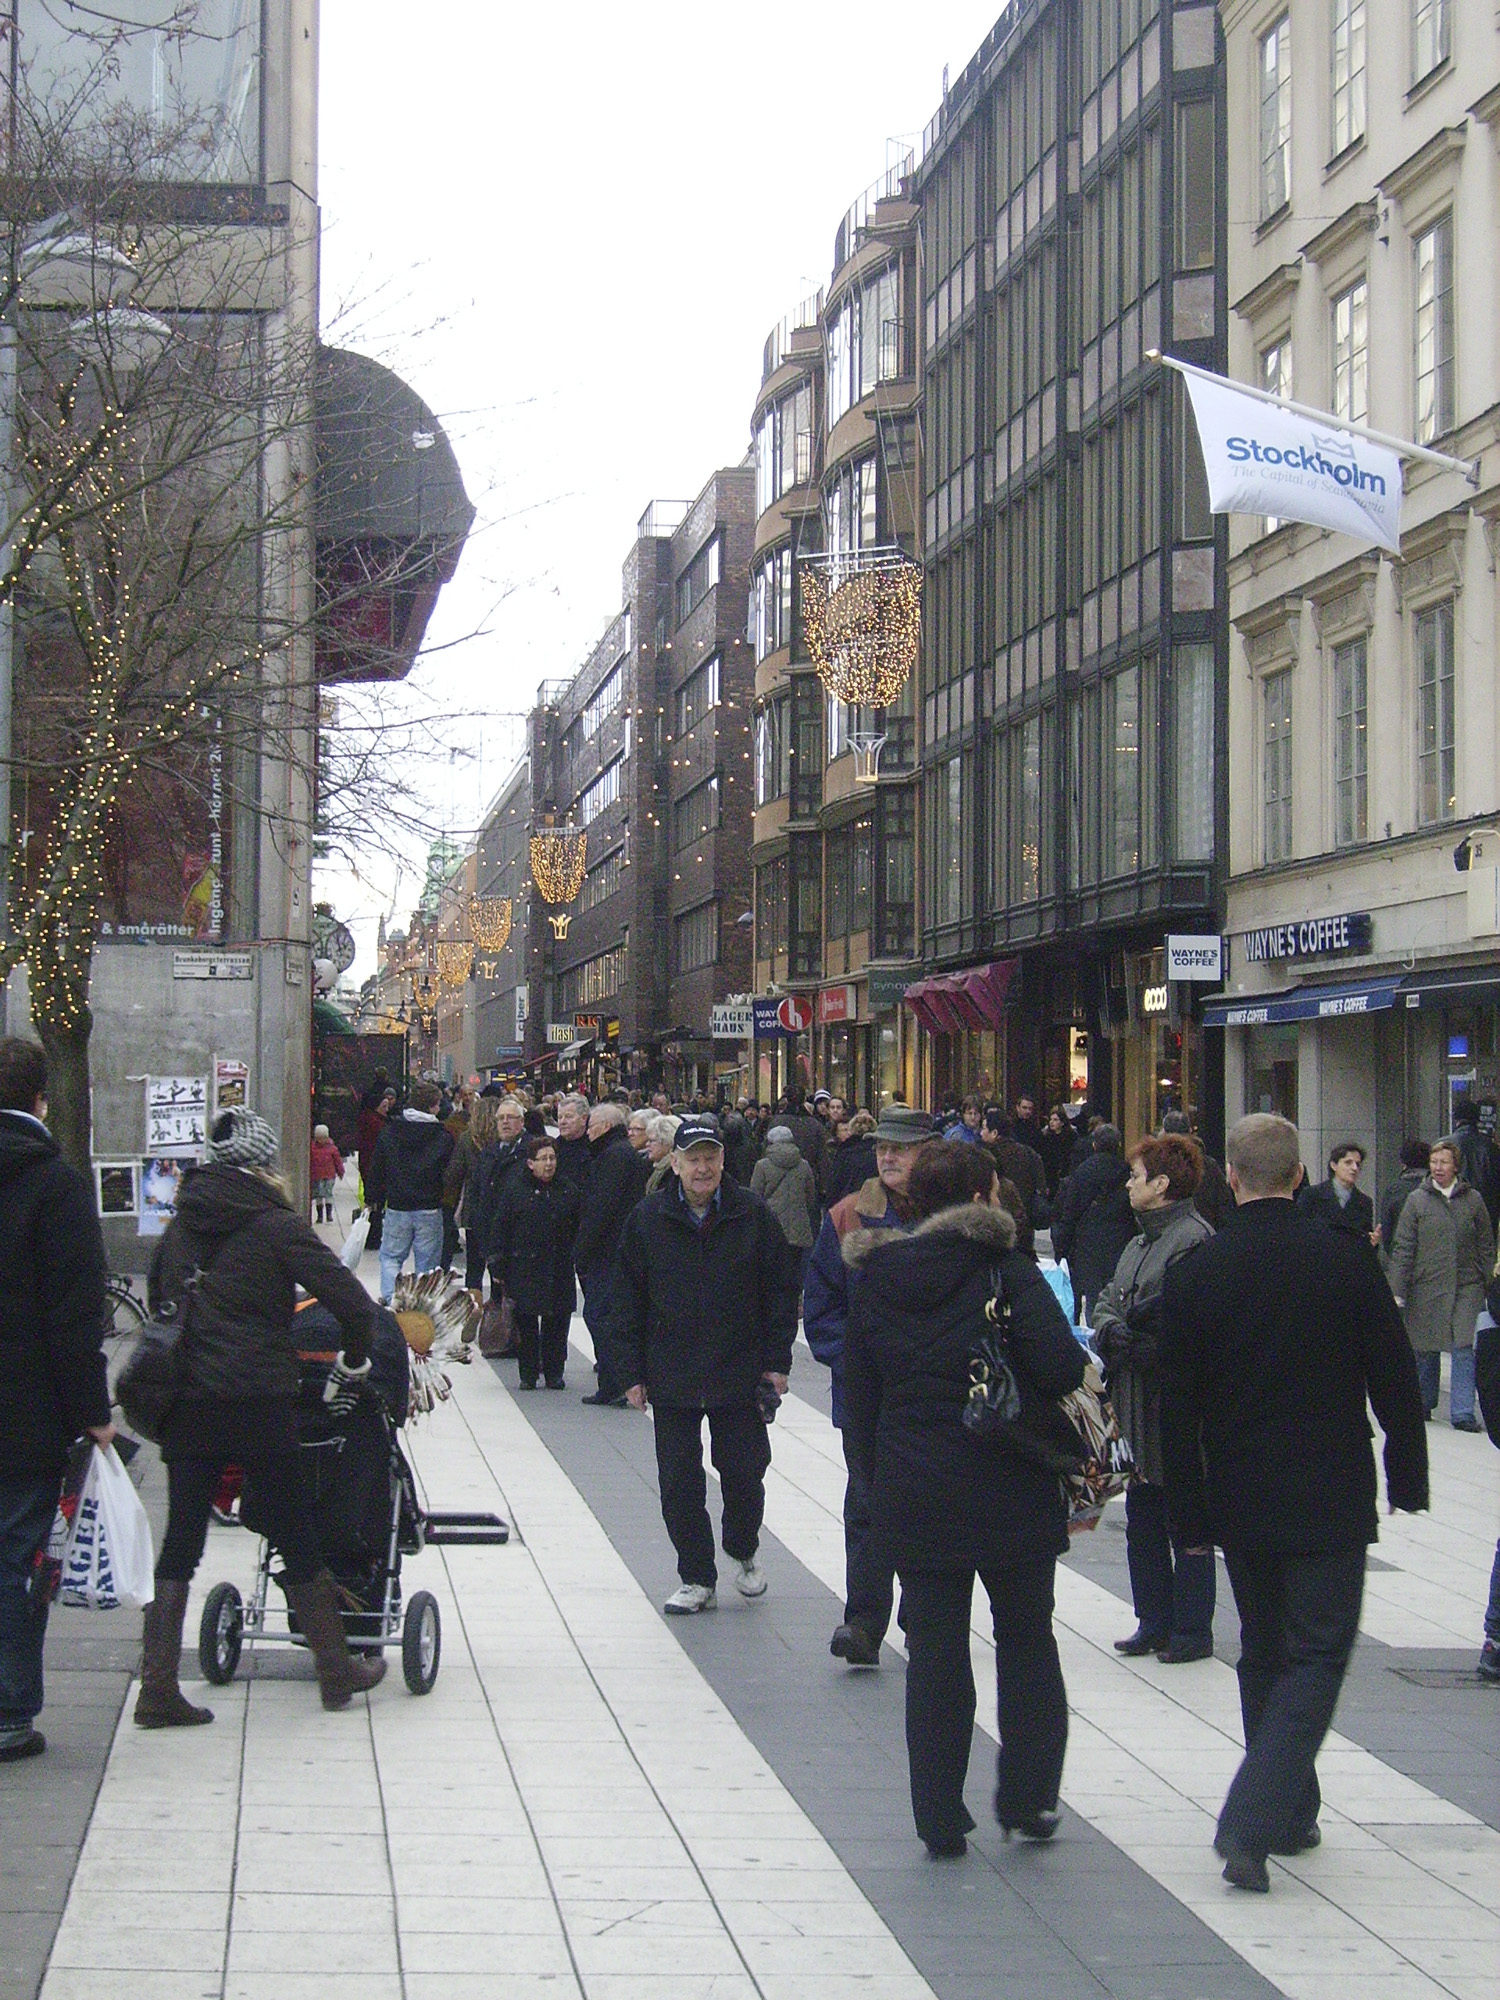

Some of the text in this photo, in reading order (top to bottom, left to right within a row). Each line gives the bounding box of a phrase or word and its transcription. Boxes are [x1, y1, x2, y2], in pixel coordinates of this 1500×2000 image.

[1226, 437, 1386, 495] Stockholm
[1232, 465, 1385, 513] The Capital of Scanavia
[101, 922, 195, 936] & smårätter
[1243, 916, 1350, 962] WAYNE'S COFFEE
[1171, 949, 1218, 958] WAYNE'S
[1174, 958, 1214, 967] COFFEE
[873, 982, 909, 992] synop
[1144, 985, 1167, 1012] ecco
[713, 1011, 753, 1022] LAGER
[755, 1010, 776, 1018] WAY
[713, 1023, 745, 1033] HAUS
